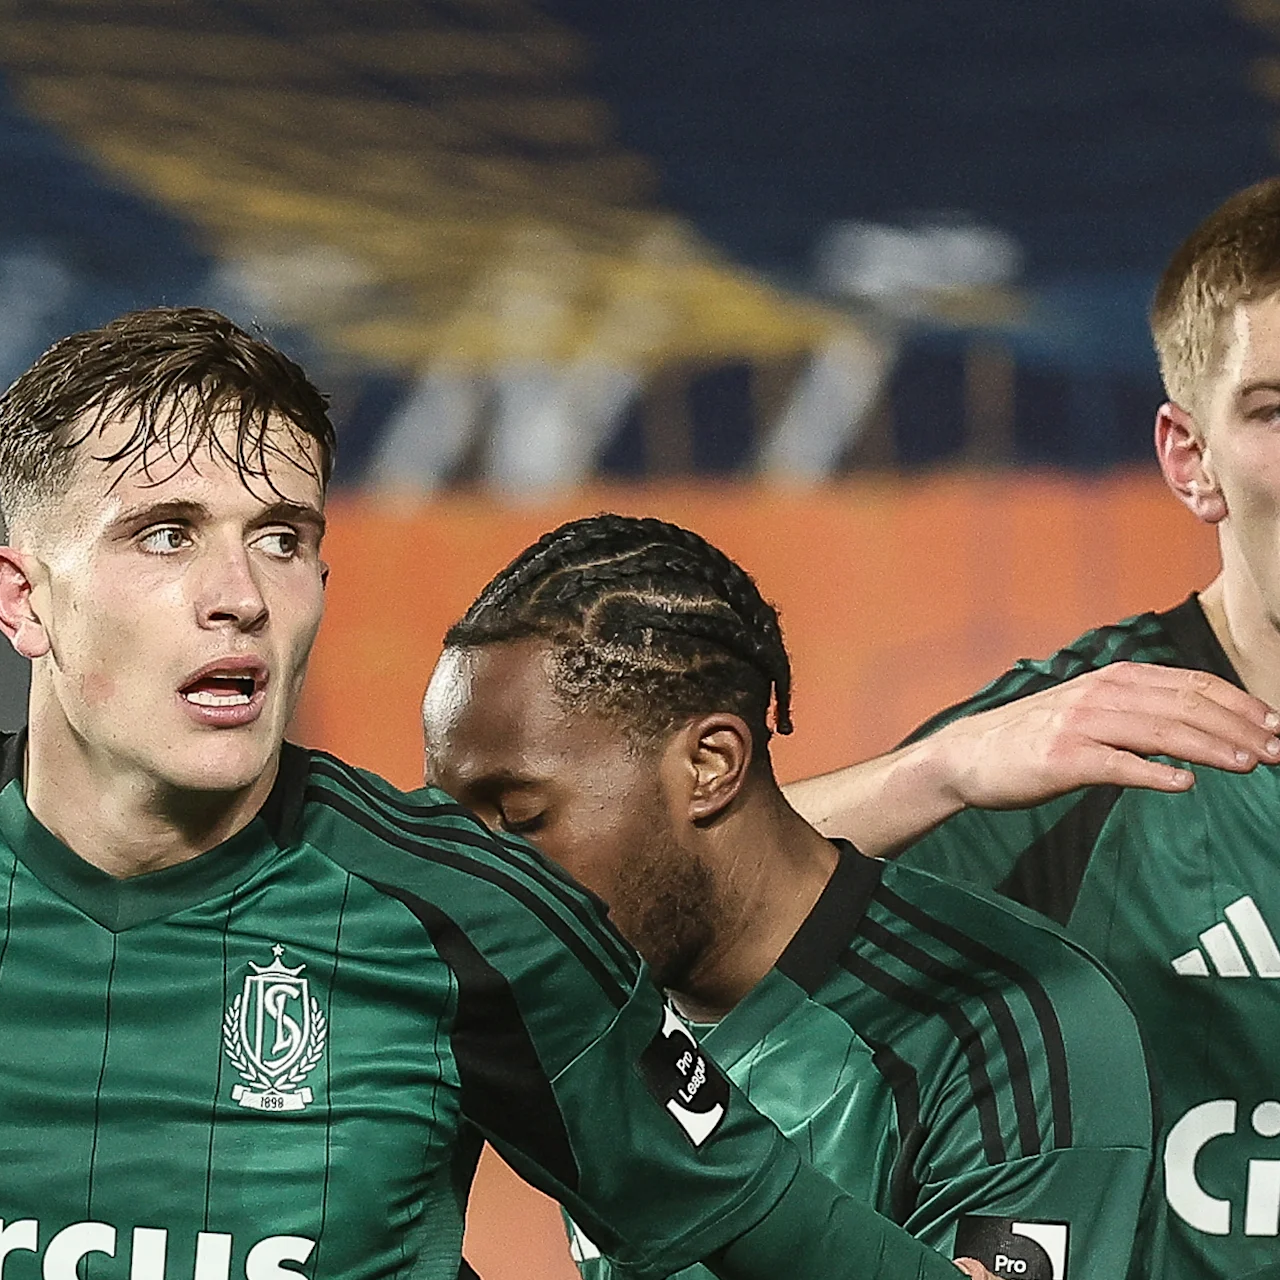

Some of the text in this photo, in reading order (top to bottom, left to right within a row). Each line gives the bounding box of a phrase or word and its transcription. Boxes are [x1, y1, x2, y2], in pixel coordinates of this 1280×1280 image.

[676, 1050, 693, 1076] Pro
[260, 1096, 284, 1109] 1898
[994, 1254, 1027, 1274] Pro
